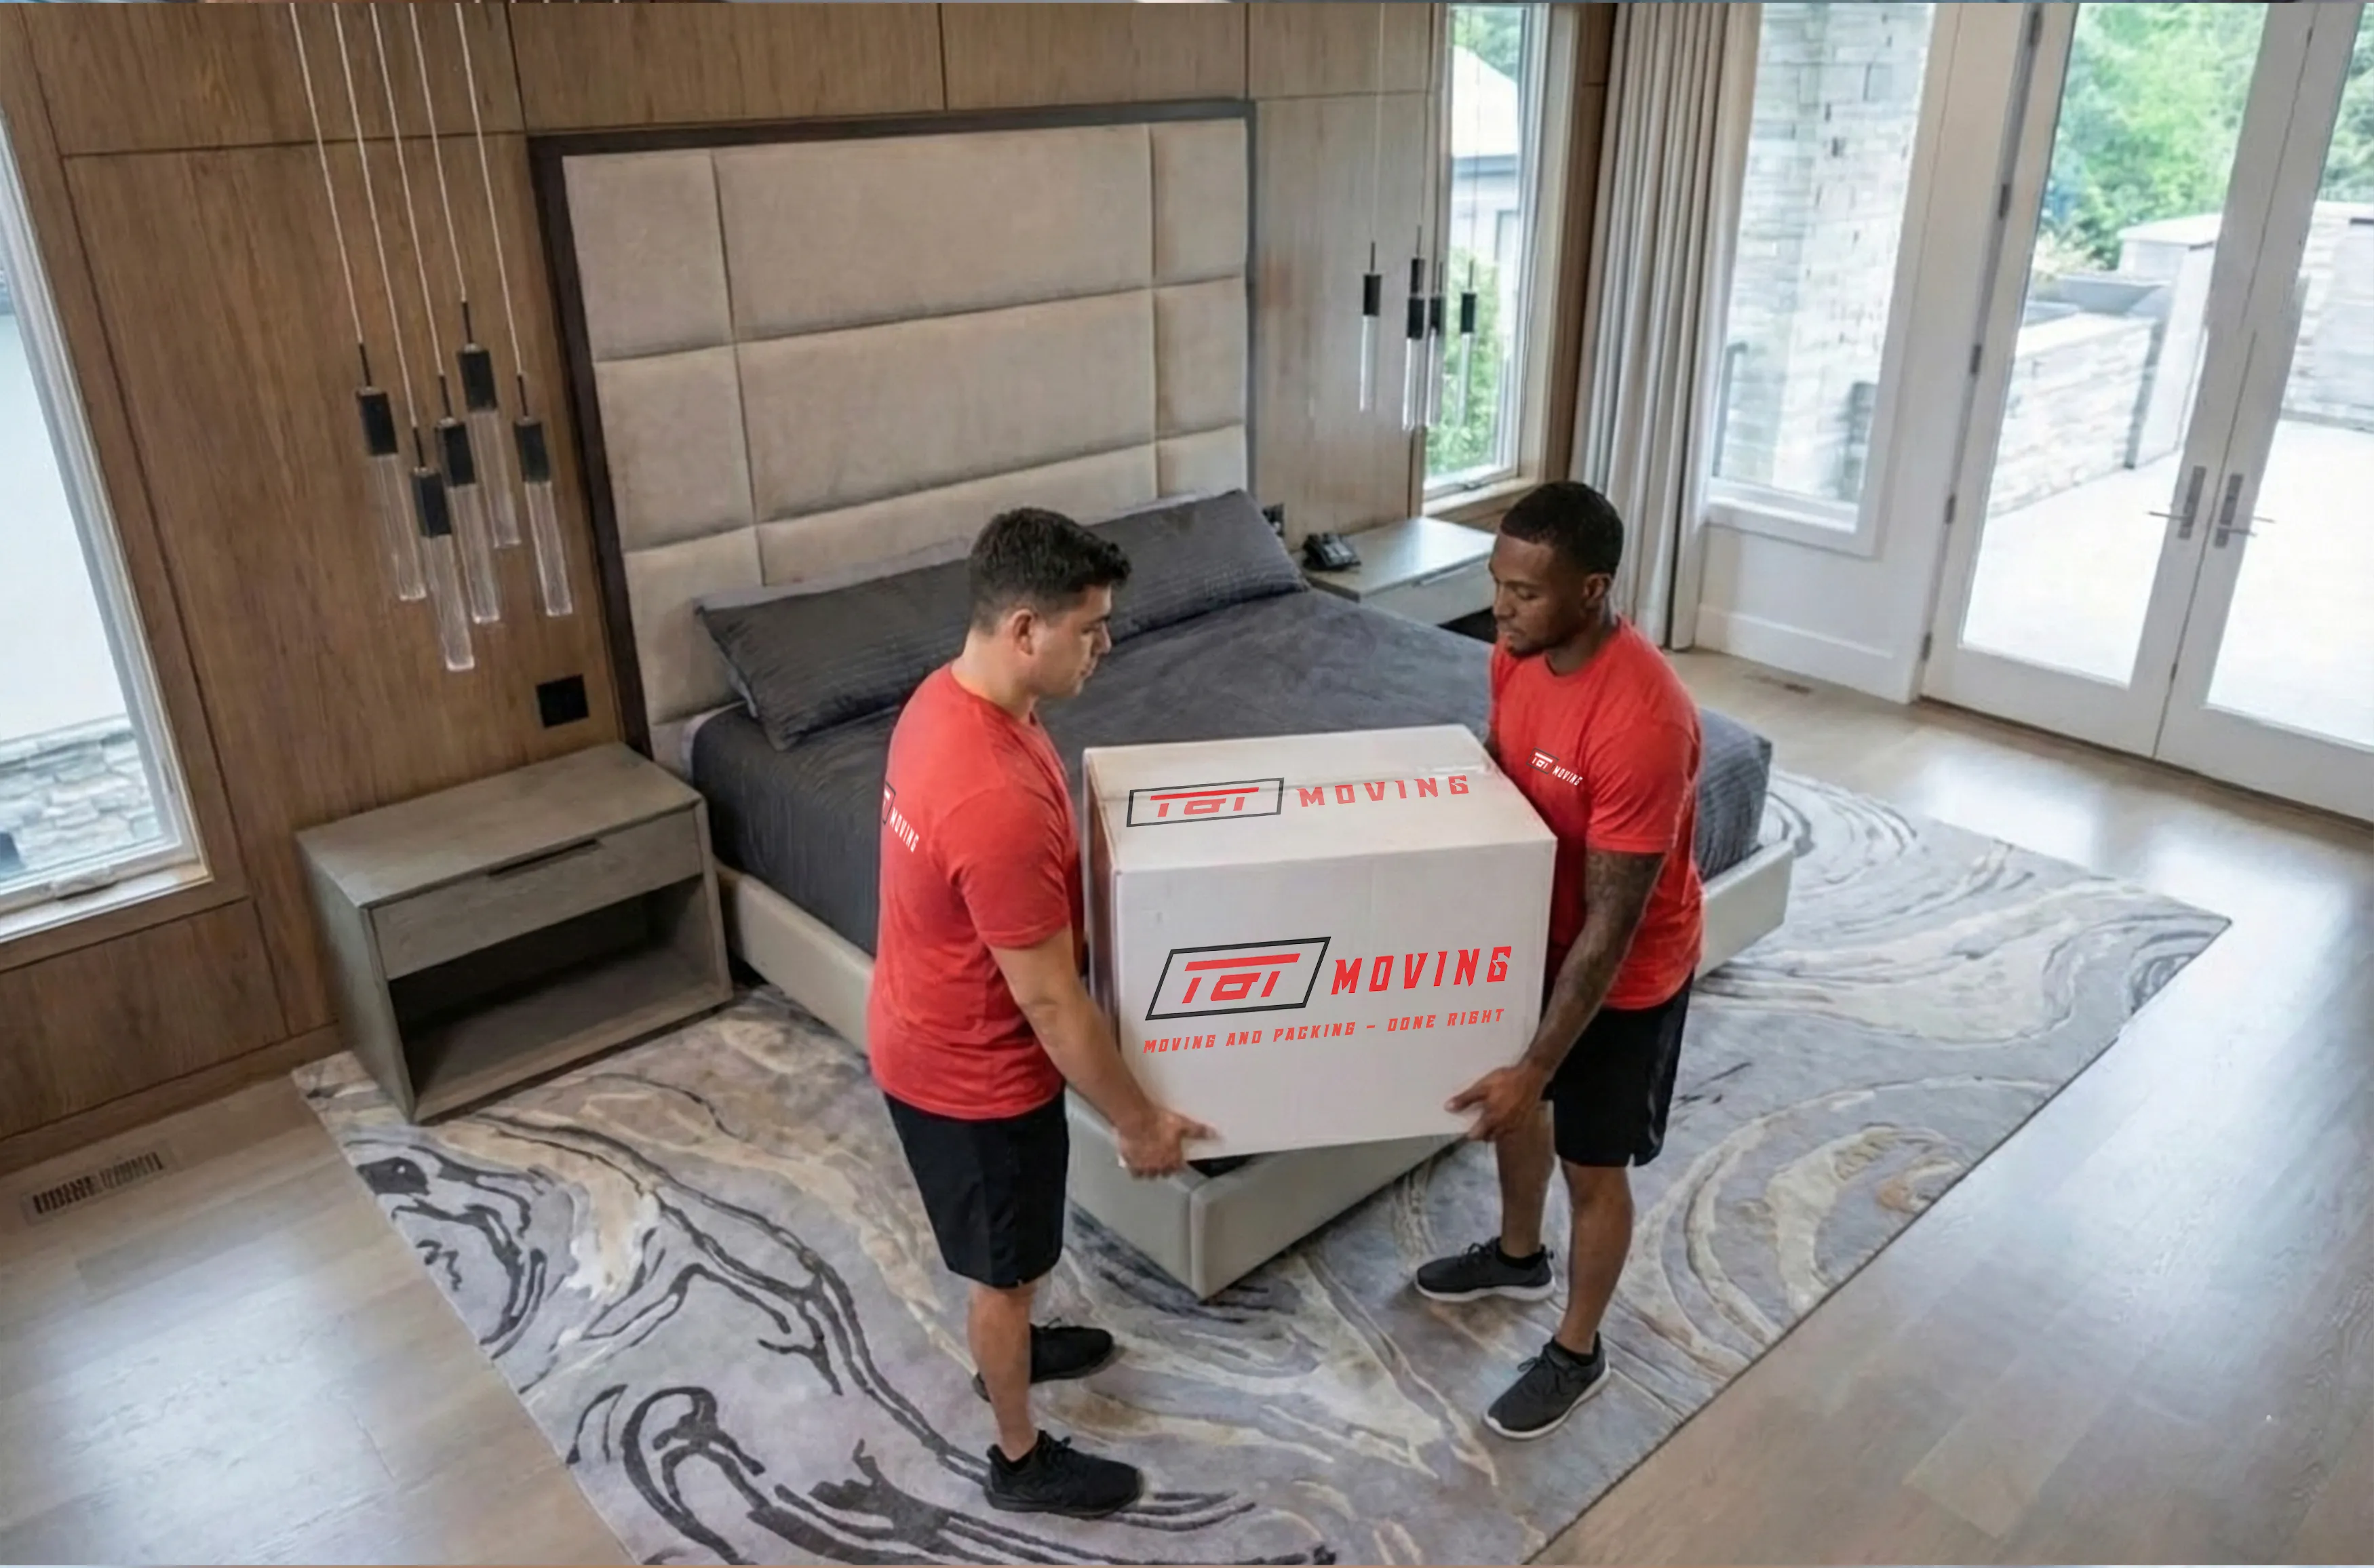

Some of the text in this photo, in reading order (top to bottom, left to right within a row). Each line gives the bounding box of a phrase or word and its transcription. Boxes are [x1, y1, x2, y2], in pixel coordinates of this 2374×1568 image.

[1296, 775, 1469, 808] MOVING
[1552, 765, 1583, 786] MOVING
[889, 806, 919, 852] MOVING
[1330, 945, 1513, 996] MOVING
[1143, 1034, 1216, 1055] MOVING
[1225, 1030, 1262, 1046] AND
[1272, 1021, 1356, 1042] PACKING
[1387, 1014, 1437, 1032] DONE
[1447, 1008, 1505, 1027] RIGHT
